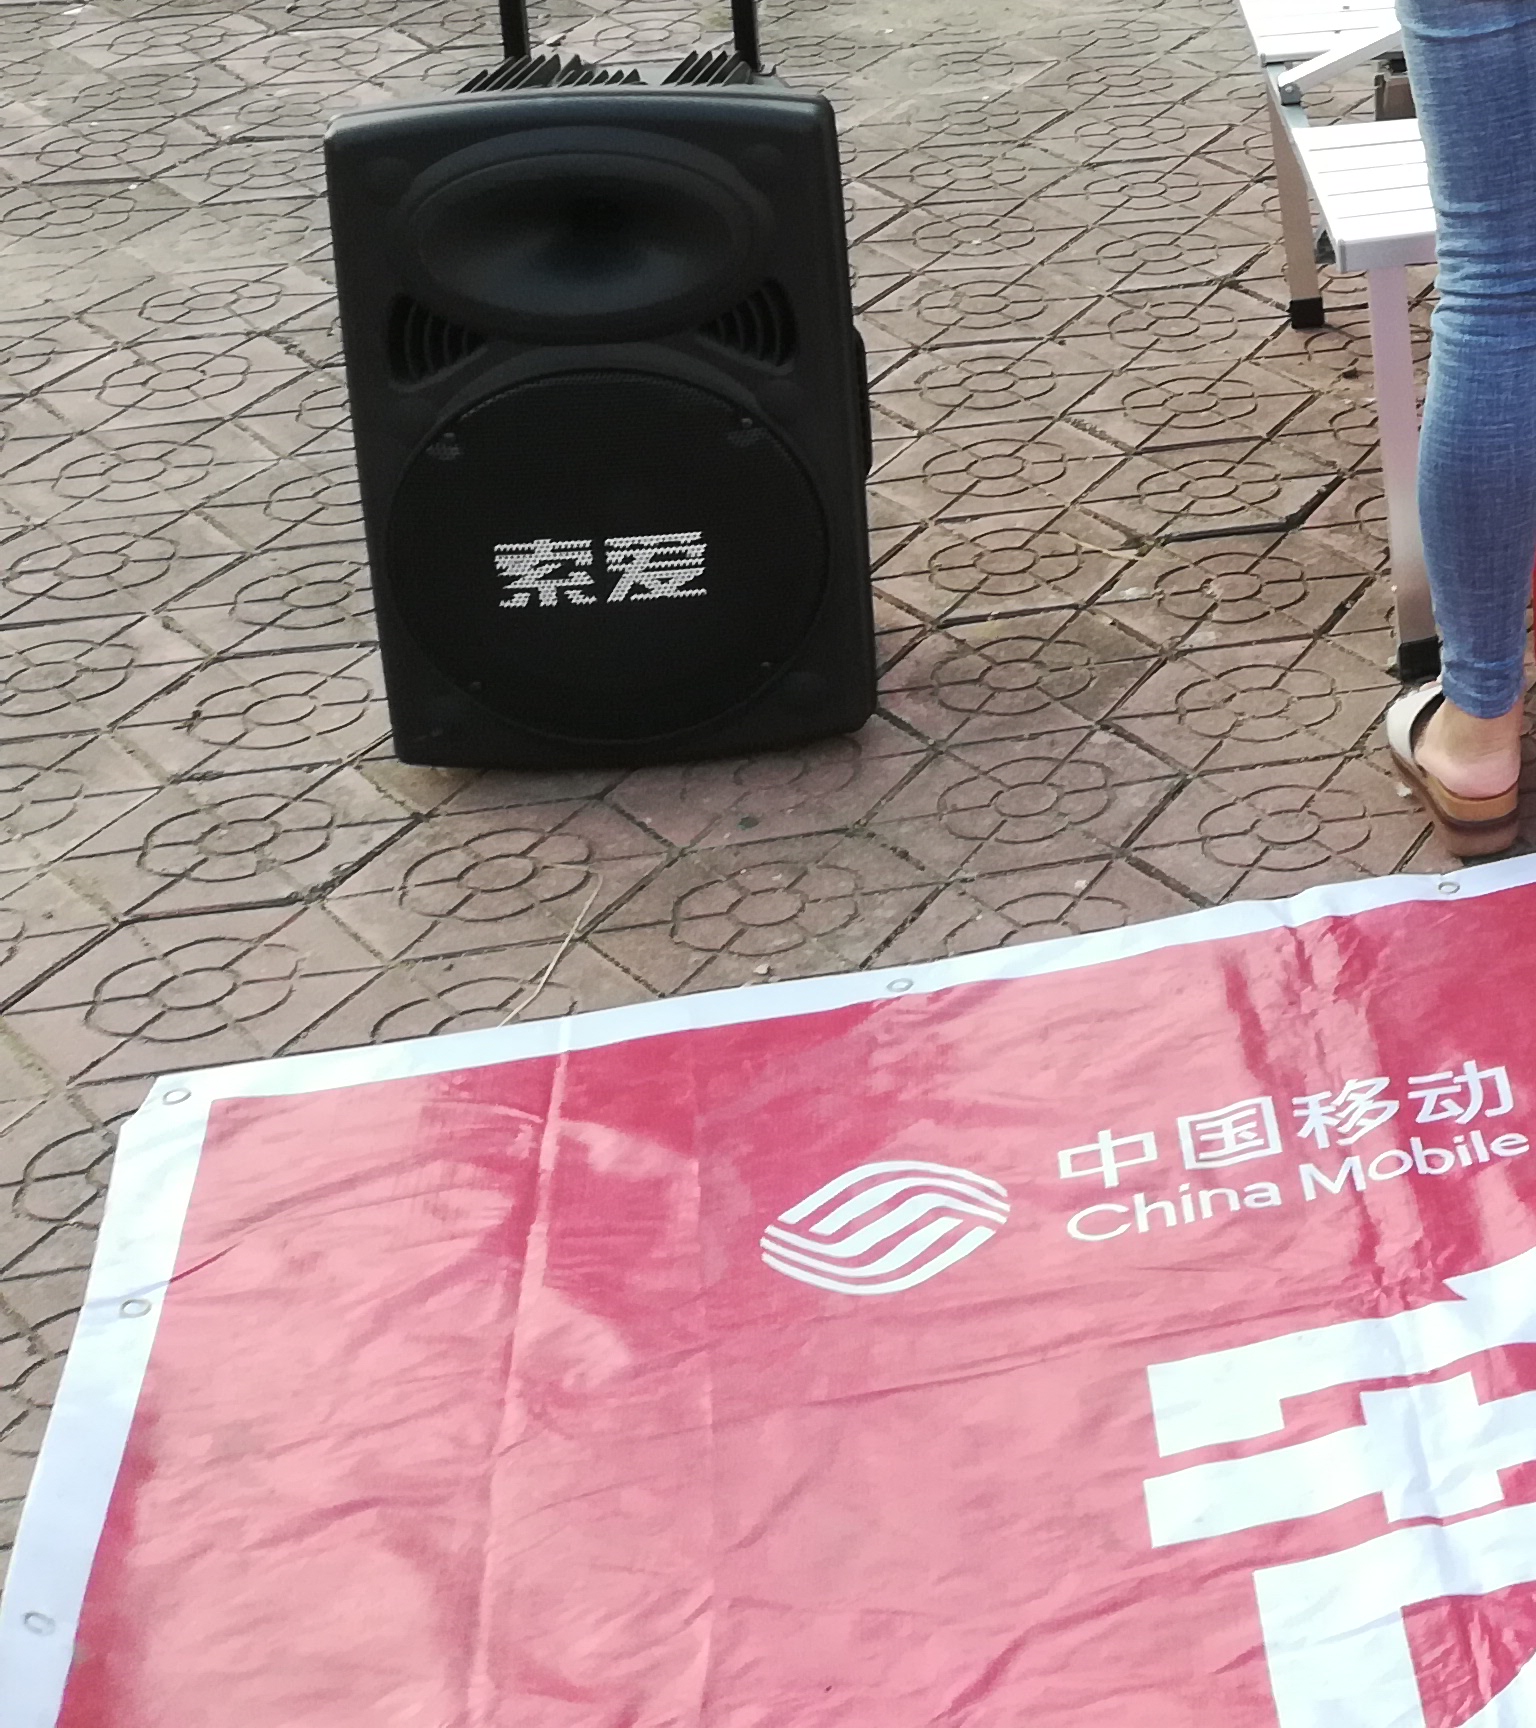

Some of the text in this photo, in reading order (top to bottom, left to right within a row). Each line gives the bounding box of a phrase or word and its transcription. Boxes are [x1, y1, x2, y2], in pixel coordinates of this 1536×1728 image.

[494, 531, 707, 607] 索爱
[1057, 1057, 1517, 1189] 中国移动
[1065, 1127, 1532, 1244] China Mobile
